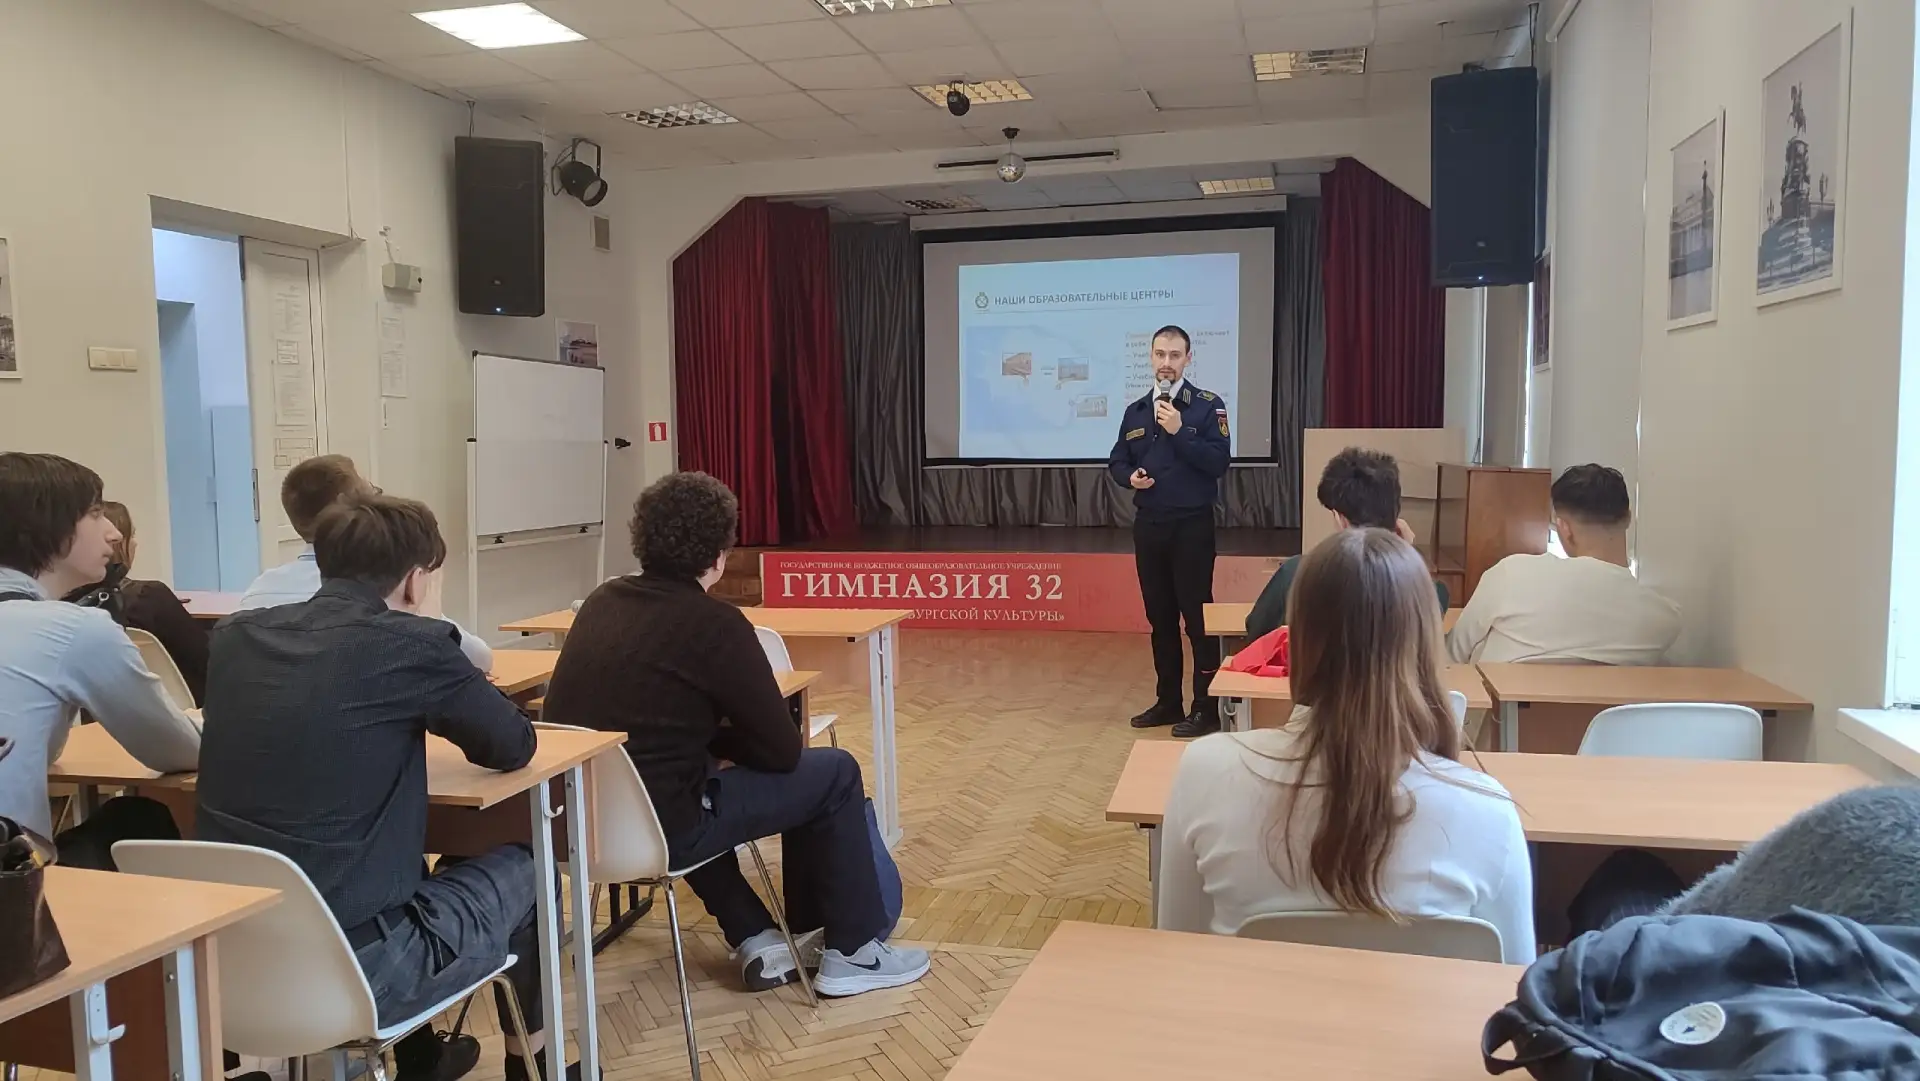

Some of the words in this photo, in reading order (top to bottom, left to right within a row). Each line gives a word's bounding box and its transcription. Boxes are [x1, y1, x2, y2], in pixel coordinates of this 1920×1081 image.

[994, 295, 1026, 306] НАШИ
[1028, 291, 1128, 304] ОБРАЗОВАТЕЛЬНЫЕ
[1130, 289, 1174, 303] ЦЕНТРЫ
[780, 561, 852, 570] ГОСУДАРСТВЕННОЕ
[853, 562, 905, 570] БЮДЖЕТНОЕ
[905, 562, 1005, 571] ОБЩЕОБРАЗОВАТЕЛЬНОЕ
[1006, 562, 1062, 571] УЧРЕЖДЕНИЕ
[781, 572, 1011, 599] ГИМНАЗИЯ
[1025, 574, 1063, 600] 32
[984, 609, 1065, 621] КУЛЬТУРЫ»
